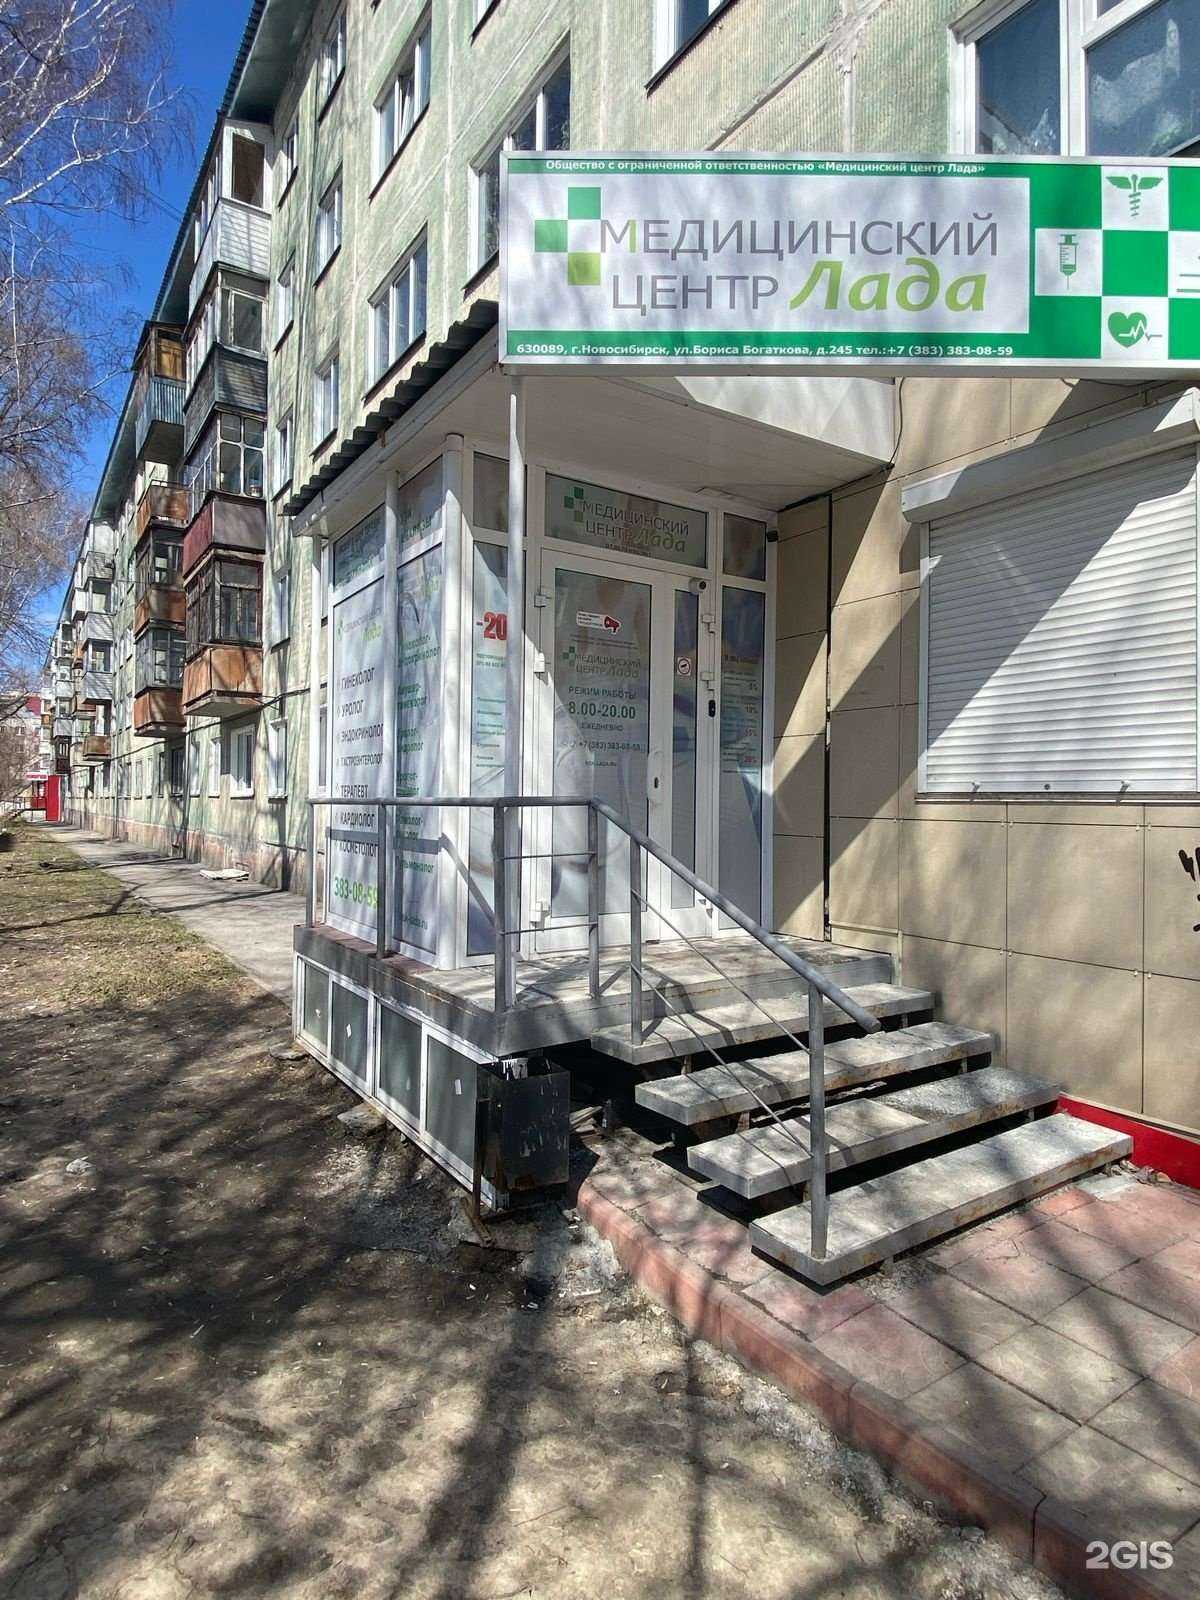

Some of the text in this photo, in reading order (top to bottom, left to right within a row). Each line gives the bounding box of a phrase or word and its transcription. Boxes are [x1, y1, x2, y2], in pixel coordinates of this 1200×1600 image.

[546, 160, 985, 175] Общество с ограниченной ответственностью «Медицинский центр Лада»
[602, 212, 997, 261] МЕДИЦИНСКИЙ
[612, 257, 987, 316] ЦЕНТР Лада
[516, 344, 1013, 357] 630089, г.Новосибирск, ул.Бориса Богаткова, д.245 тел.:+7 (383) 383-08-59
[582, 500, 689, 537] МЕДИЦИНСКИЙ
[633, 529, 686, 554] Лада
[341, 667, 375, 690] ГИНЕКОЛОГ
[568, 685, 636, 701] РЕЖИМ РАБОТЫ
[341, 699, 364, 718] УРОЛОГ
[568, 701, 636, 720] 8.00-20.00
[340, 784, 369, 799] ТЕРАПЕВТ
[339, 811, 376, 829] КАРДИОЛОГ
[339, 840, 379, 857] КОСМЕТОЛОГ
[334, 876, 379, 909] 383-08-59
